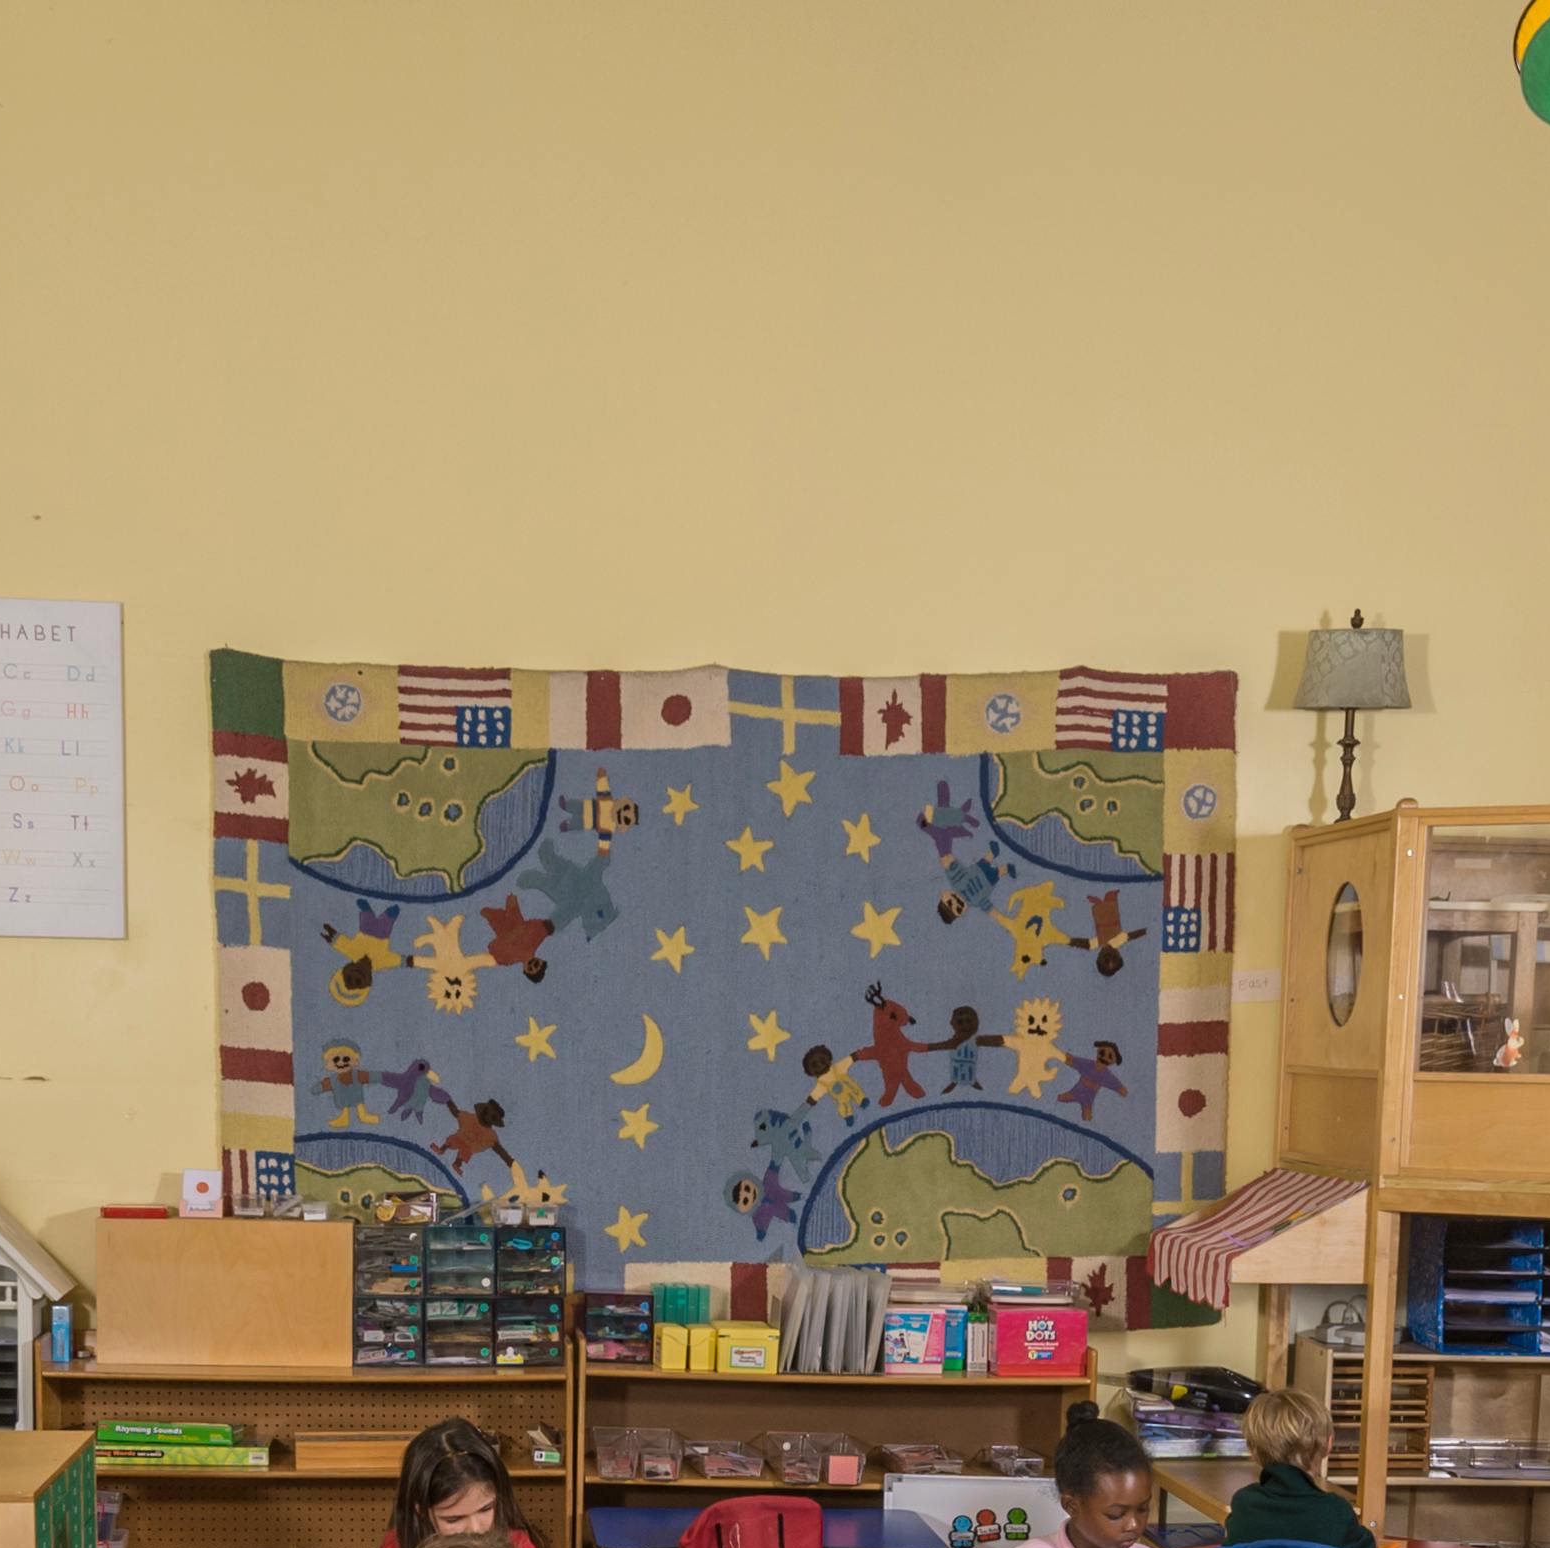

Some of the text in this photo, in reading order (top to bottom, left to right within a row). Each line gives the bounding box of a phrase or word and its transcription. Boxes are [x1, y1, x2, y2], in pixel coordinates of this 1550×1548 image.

[1027, 1320, 1055, 1332] HOT
[1025, 1330, 1057, 1342] DOTS
[114, 1424, 152, 1437] Rhyming
[152, 1424, 184, 1436] Sounds
